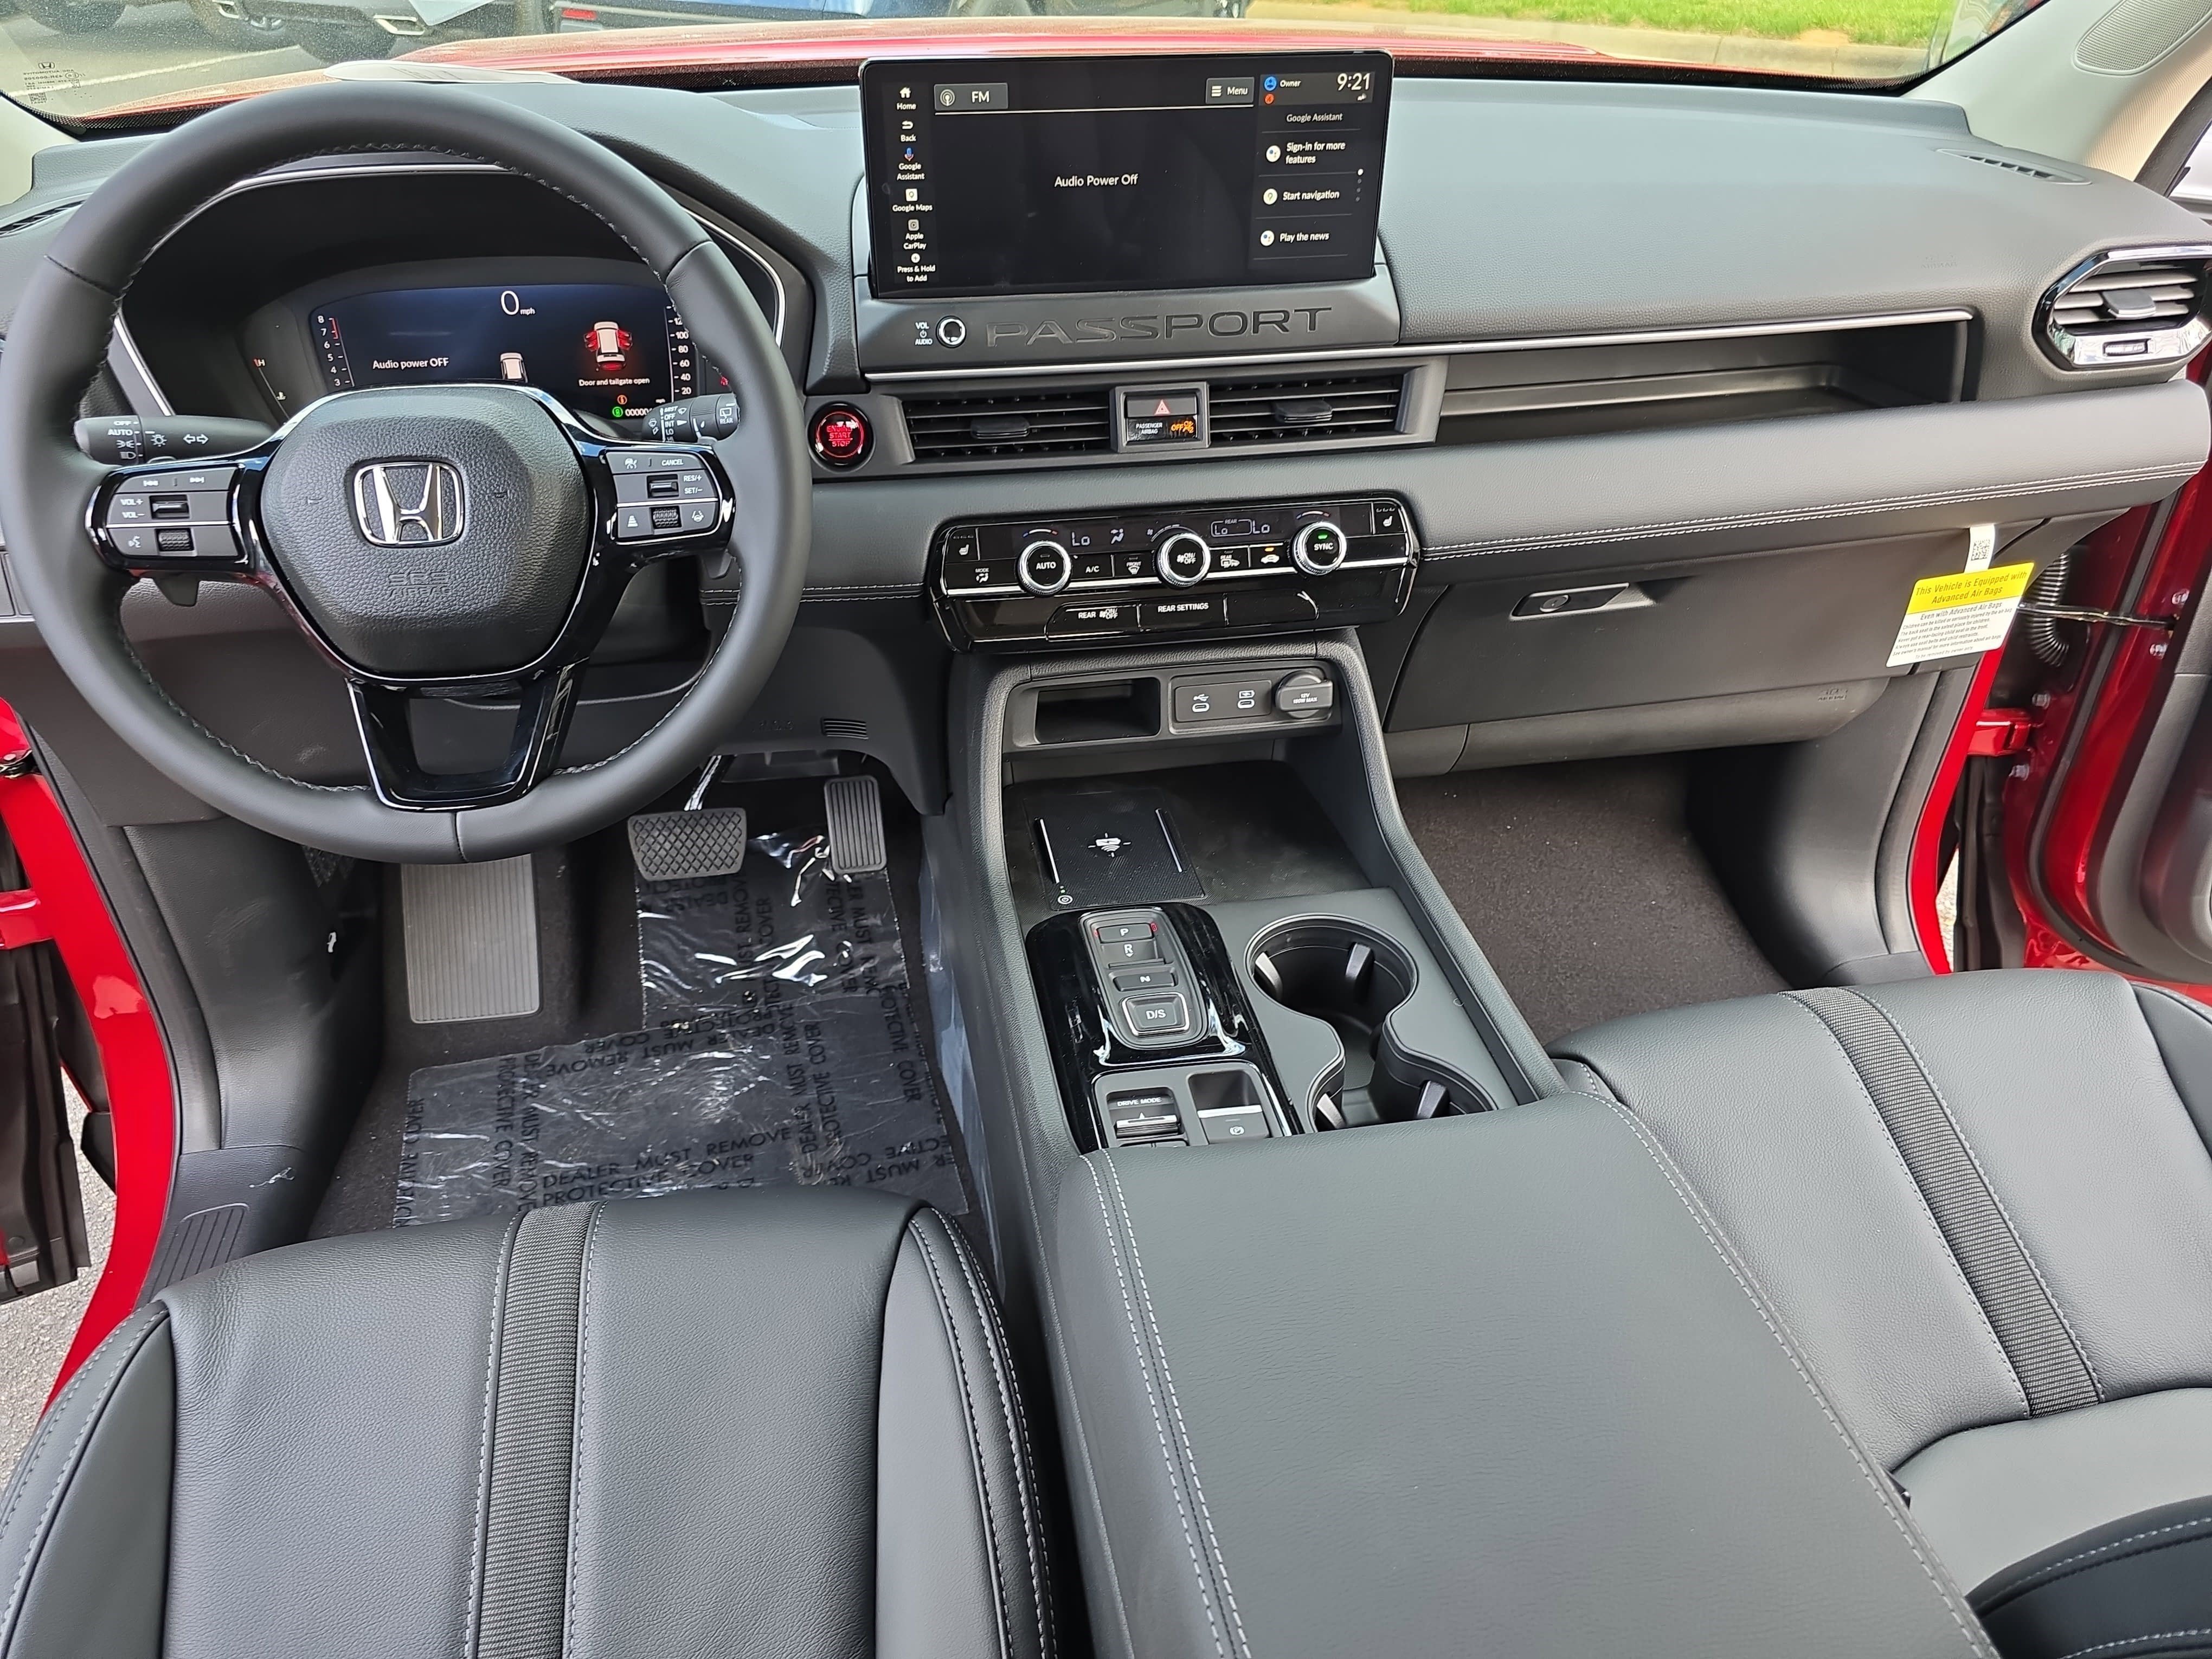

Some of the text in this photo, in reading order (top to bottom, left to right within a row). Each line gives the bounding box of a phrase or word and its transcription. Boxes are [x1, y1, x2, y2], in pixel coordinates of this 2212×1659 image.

[1279, 79, 1301, 88] Owner
[1336, 73, 1371, 91] 9:21
[1227, 86, 1248, 95] Menu
[972, 91, 990, 103] FM
[896, 102, 916, 110] Home
[1286, 113, 1343, 123] Google Assistant
[901, 134, 916, 143] Back
[1286, 142, 1346, 152] Sign-in for more
[1285, 155, 1316, 164] features
[898, 163, 922, 171] Google
[897, 172, 925, 181] Assistant
[1054, 173, 1139, 188] Audio Power Off
[1282, 190, 1340, 201] Start navigation
[892, 203, 933, 213] Google Maps
[905, 232, 924, 241] Apple
[1279, 232, 1329, 243] Play the news
[903, 241, 927, 250] CarPlay
[897, 265, 913, 273] Press
[500, 290, 536, 317] 0 mph
[317, 316, 325, 324] 8
[674, 318, 683, 326] 12
[915, 321, 929, 330] VOL
[986, 306, 1333, 349] PASSPORT
[320, 328, 327, 336] 7
[676, 331, 689, 339] 100
[324, 341, 330, 349] 6
[678, 345, 689, 353] 80
[327, 353, 334, 362] 5
[372, 357, 449, 371] Audio power OFF
[679, 359, 690, 368] 60
[330, 365, 337, 374] 4
[578, 378, 596, 387] Door
[609, 377, 633, 387] tailgate
[634, 377, 650, 387] open
[680, 373, 691, 381] 40
[334, 378, 341, 387] 3
[681, 387, 692, 395] 20
[108, 428, 133, 436] AUTO
[1171, 423, 1184, 432] OFF
[1314, 543, 1334, 551] SYNC
[1036, 561, 1057, 570] AUTO
[1085, 565, 1100, 574] A/C
[388, 571, 449, 585] SRS
[1915, 587, 1931, 596] This
[1934, 582, 1963, 593] Vehicle
[1973, 574, 2009, 588] Equipped
[2010, 571, 2027, 580] with
[1932, 587, 2002, 604] Advanced Air Bags
[1157, 602, 1210, 613] REAR SETTINGS
[1920, 612, 1934, 620] Even
[1949, 606, 1977, 615] Advanced
[1988, 601, 2002, 609] Bags
[1078, 611, 1096, 619] REAR
[1120, 928, 1129, 937] P
[1124, 944, 1134, 954] R
[1146, 1009, 1167, 1020] D/S
[780, 1002, 801, 1056] REMOVE
[584, 1032, 650, 1054] COVER
[804, 1023, 826, 1065] COVER
[643, 1039, 694, 1059] MUST
[546, 1050, 629, 1077] REMOVE
[786, 1063, 807, 1097] MUST
[896, 1059, 922, 1103] COVER
[1117, 1096, 1162, 1107] DRIVE MODE
[543, 1127, 792, 1189] DEALER MUST REMOVE
[492, 1140, 513, 1188] COVER
[867, 1158, 919, 1184] MUST
[518, 1152, 539, 1212] REMOVE
[543, 1168, 672, 1207] PROTECTIVE
